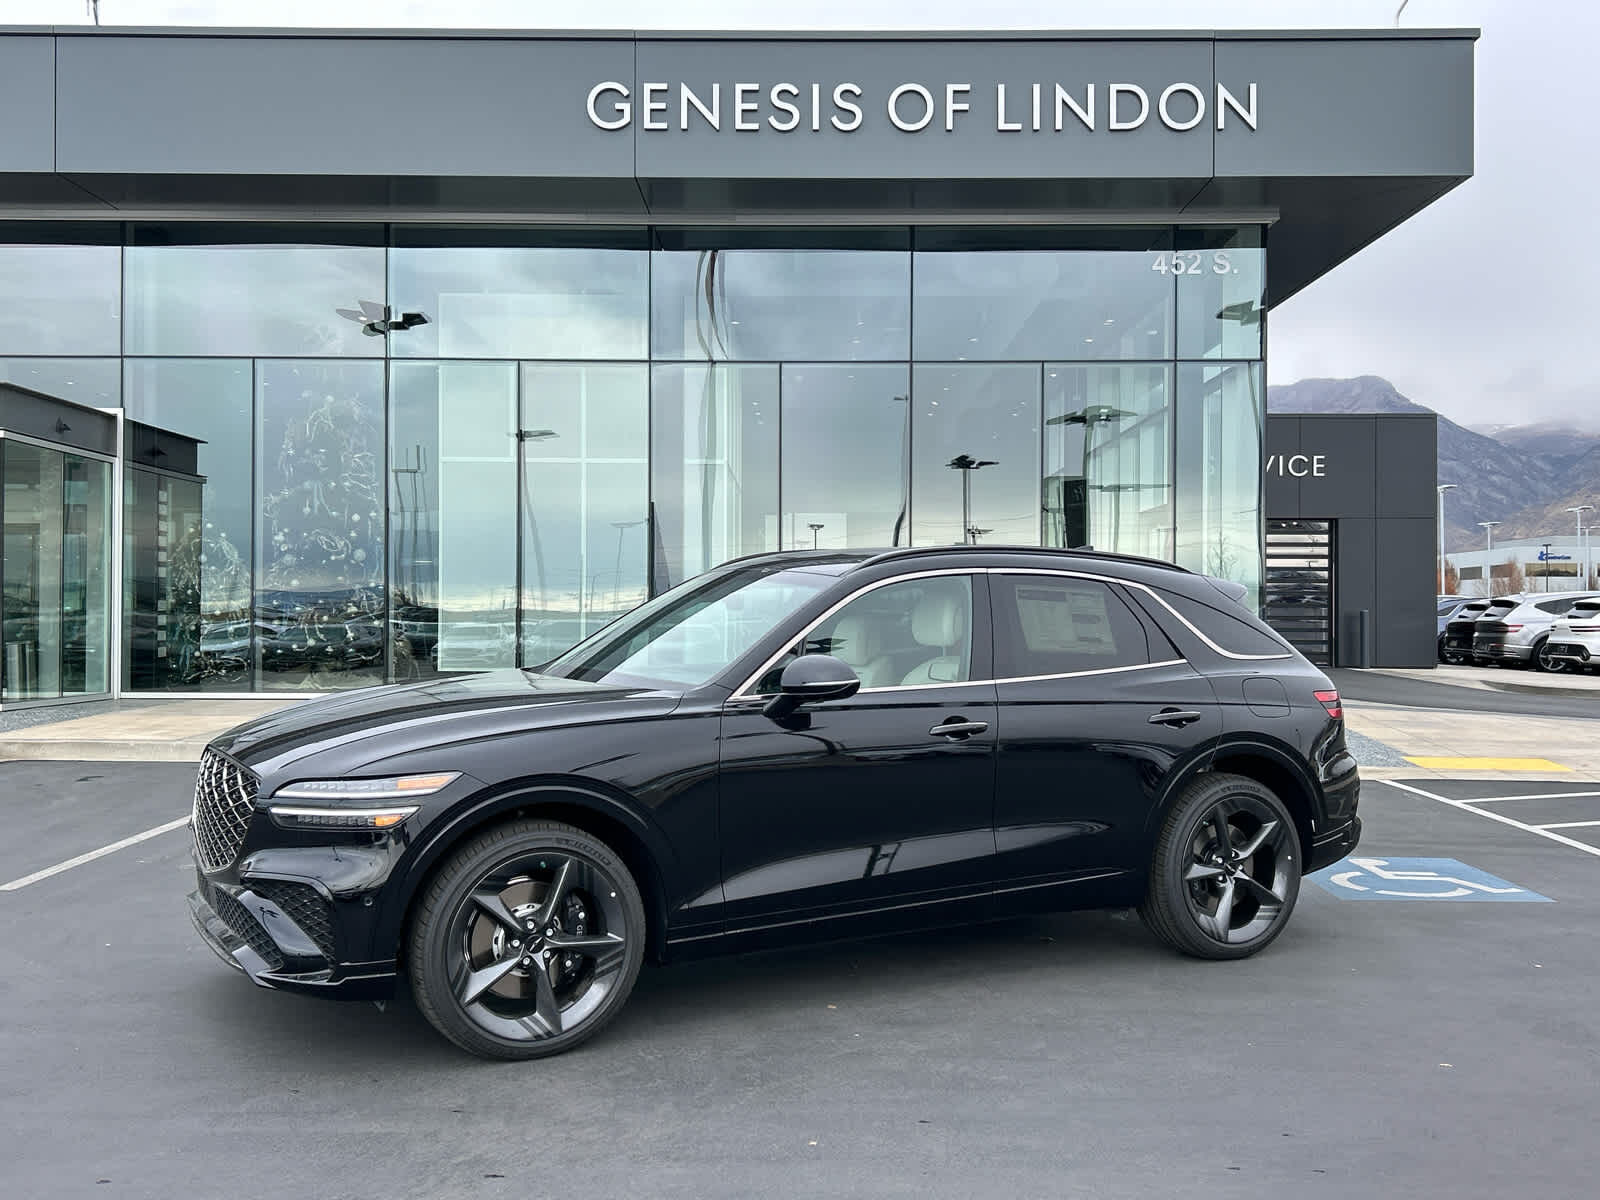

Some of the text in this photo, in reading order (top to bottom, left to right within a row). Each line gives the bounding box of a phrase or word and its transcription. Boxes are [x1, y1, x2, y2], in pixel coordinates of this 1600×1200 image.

[586, 82, 1257, 131] GENESIS OF LINDON
[1152, 253, 1239, 275] 452 S.
